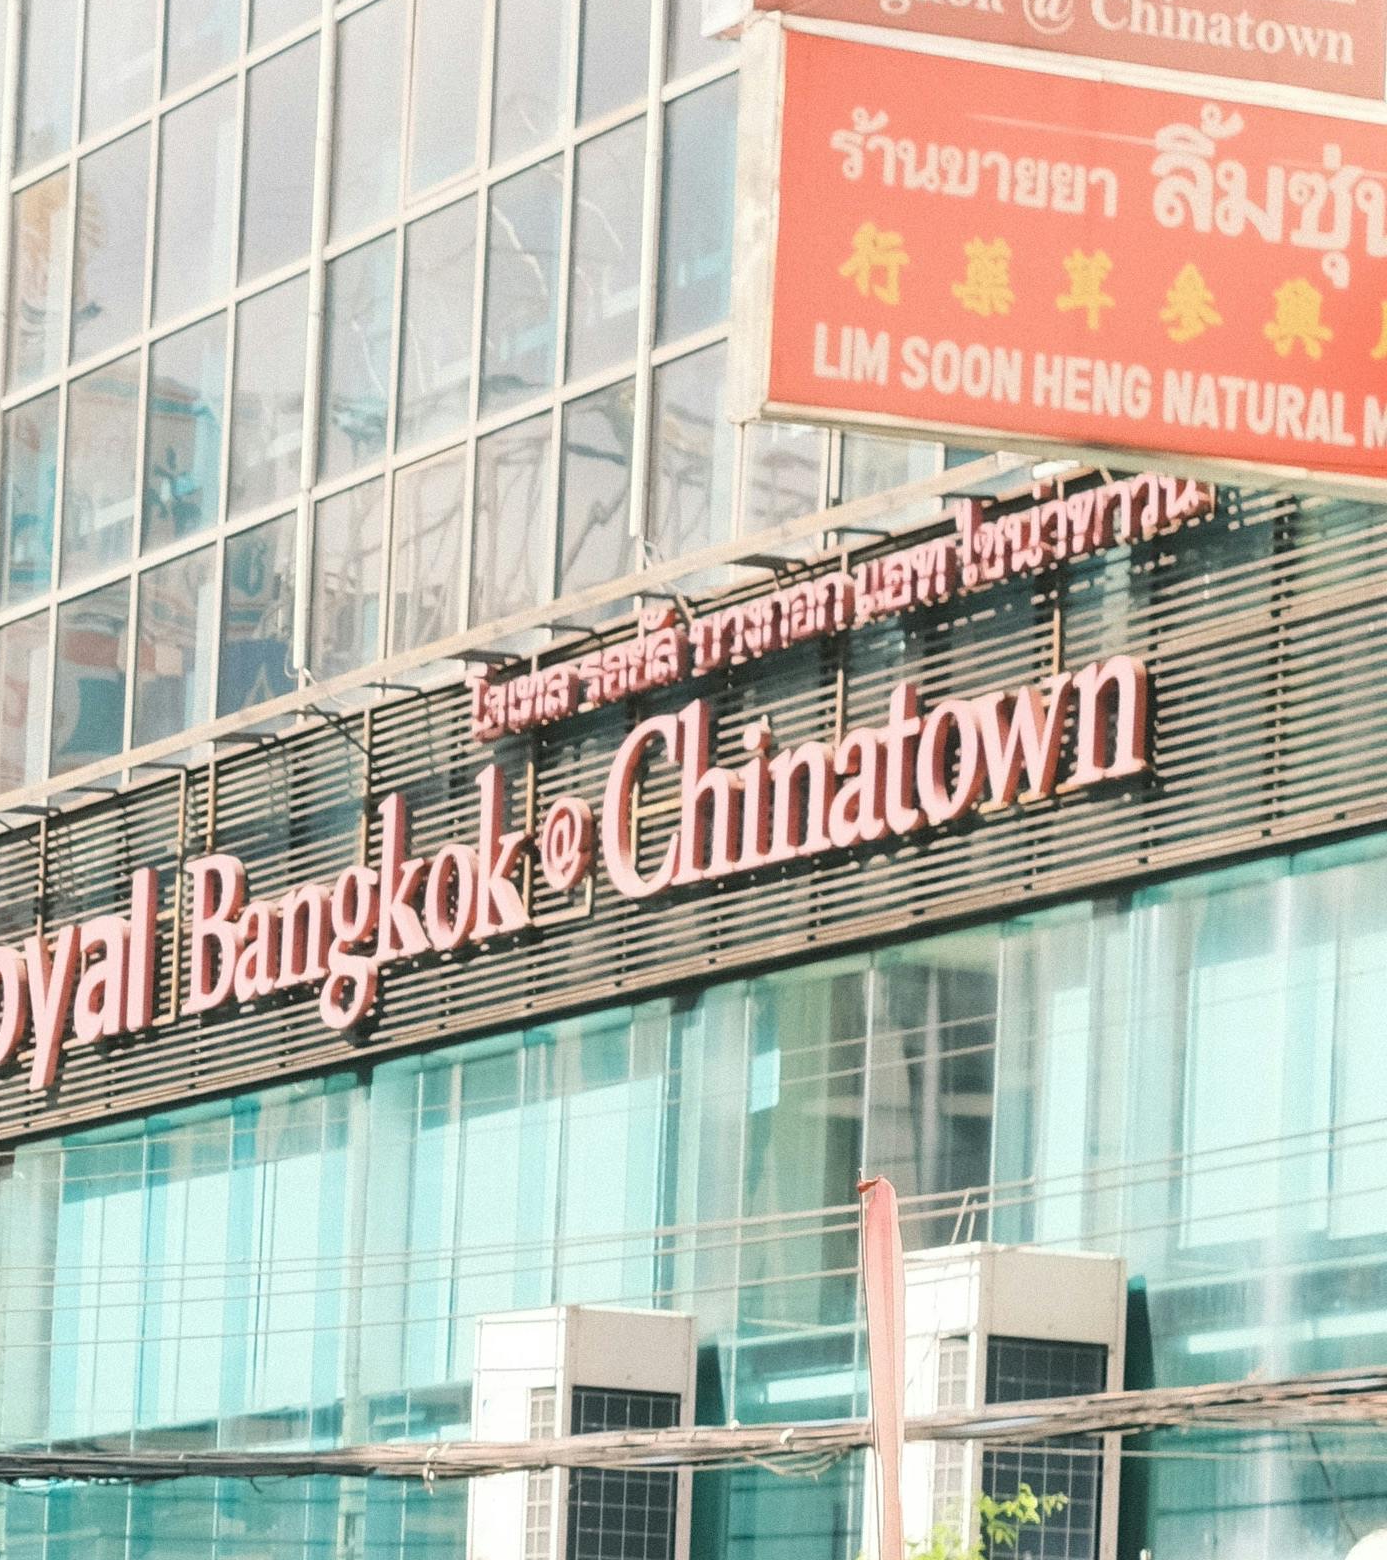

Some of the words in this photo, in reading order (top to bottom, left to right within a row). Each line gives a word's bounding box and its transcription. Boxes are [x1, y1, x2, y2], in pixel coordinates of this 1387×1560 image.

[829, 105, 1119, 219] ร้านขายยา
[812, 322, 891, 386] LIM
[900, 336, 1023, 402] SOON
[1031, 349, 1153, 422] HENG
[1162, 367, 1355, 448] NATURAL
[181, 764, 531, 1031] Bangkok
[539, 796, 593, 892] @
[600, 652, 1156, 899] Chinatown
